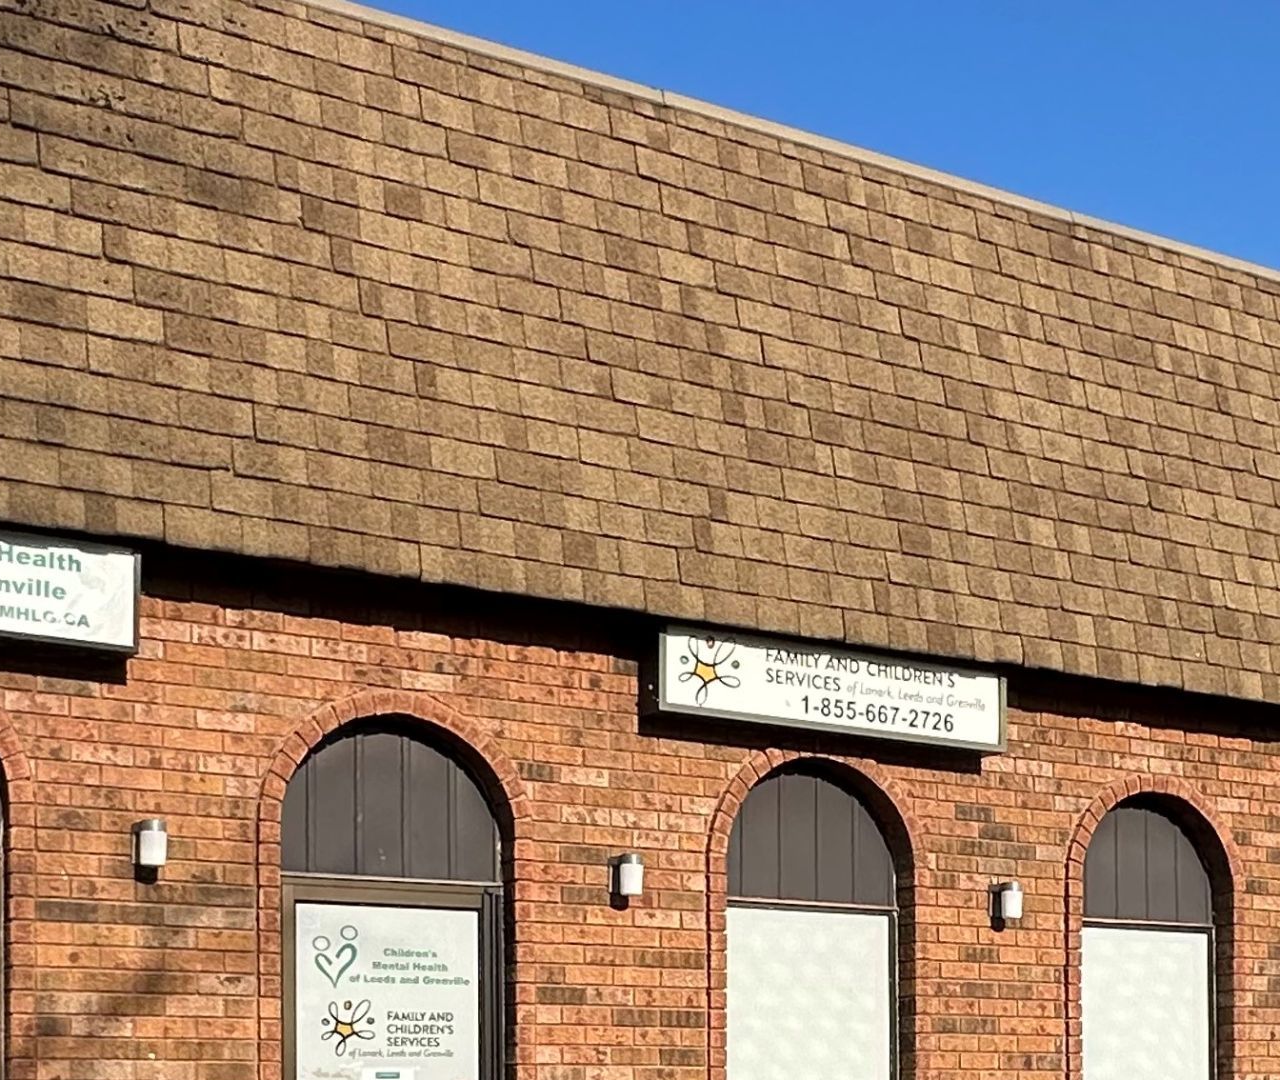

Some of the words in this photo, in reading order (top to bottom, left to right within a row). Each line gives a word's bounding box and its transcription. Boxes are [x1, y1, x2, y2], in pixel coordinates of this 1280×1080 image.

[766, 648, 820, 669] FAMILY
[825, 655, 859, 674] AND
[867, 661, 955, 688] CHILDREN'S
[765, 667, 841, 692] SERVICES
[846, 681, 859, 697] of
[926, 694, 944, 706] and
[801, 695, 954, 732] 1-855-667-2726
[383, 948, 437, 958] Children's
[372, 961, 409, 971] Mental
[412, 962, 448, 972] Health
[349, 974, 360, 983] of
[364, 975, 395, 984] Leeds
[400, 976, 419, 985] and
[387, 1011, 426, 1022] FAMILY
[429, 1012, 454, 1022] AND
[386, 1024, 454, 1035] CHILDREN'S
[386, 1037, 440, 1047] SERVICES
